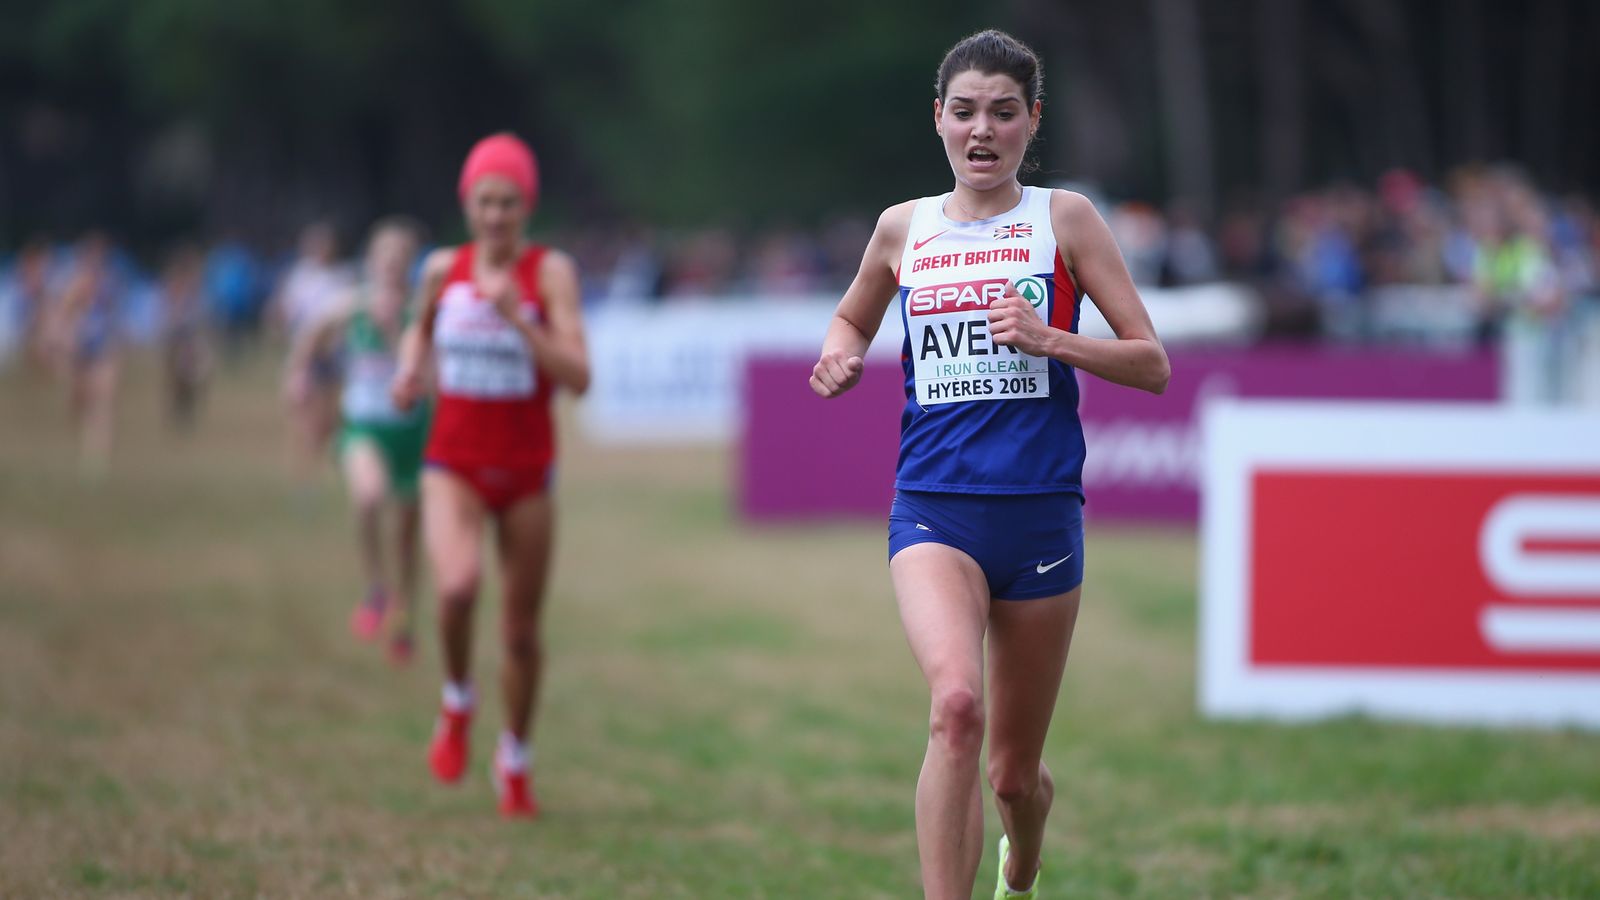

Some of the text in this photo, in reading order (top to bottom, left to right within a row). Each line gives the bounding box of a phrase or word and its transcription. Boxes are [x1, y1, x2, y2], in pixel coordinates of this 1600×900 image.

[912, 249, 1030, 273] GREAT BRITAIN
[912, 283, 1006, 312] SPAR
[943, 362, 972, 375] RUN
[976, 360, 1028, 373] CLEAN
[927, 377, 1037, 400] HYÈRES 2015
